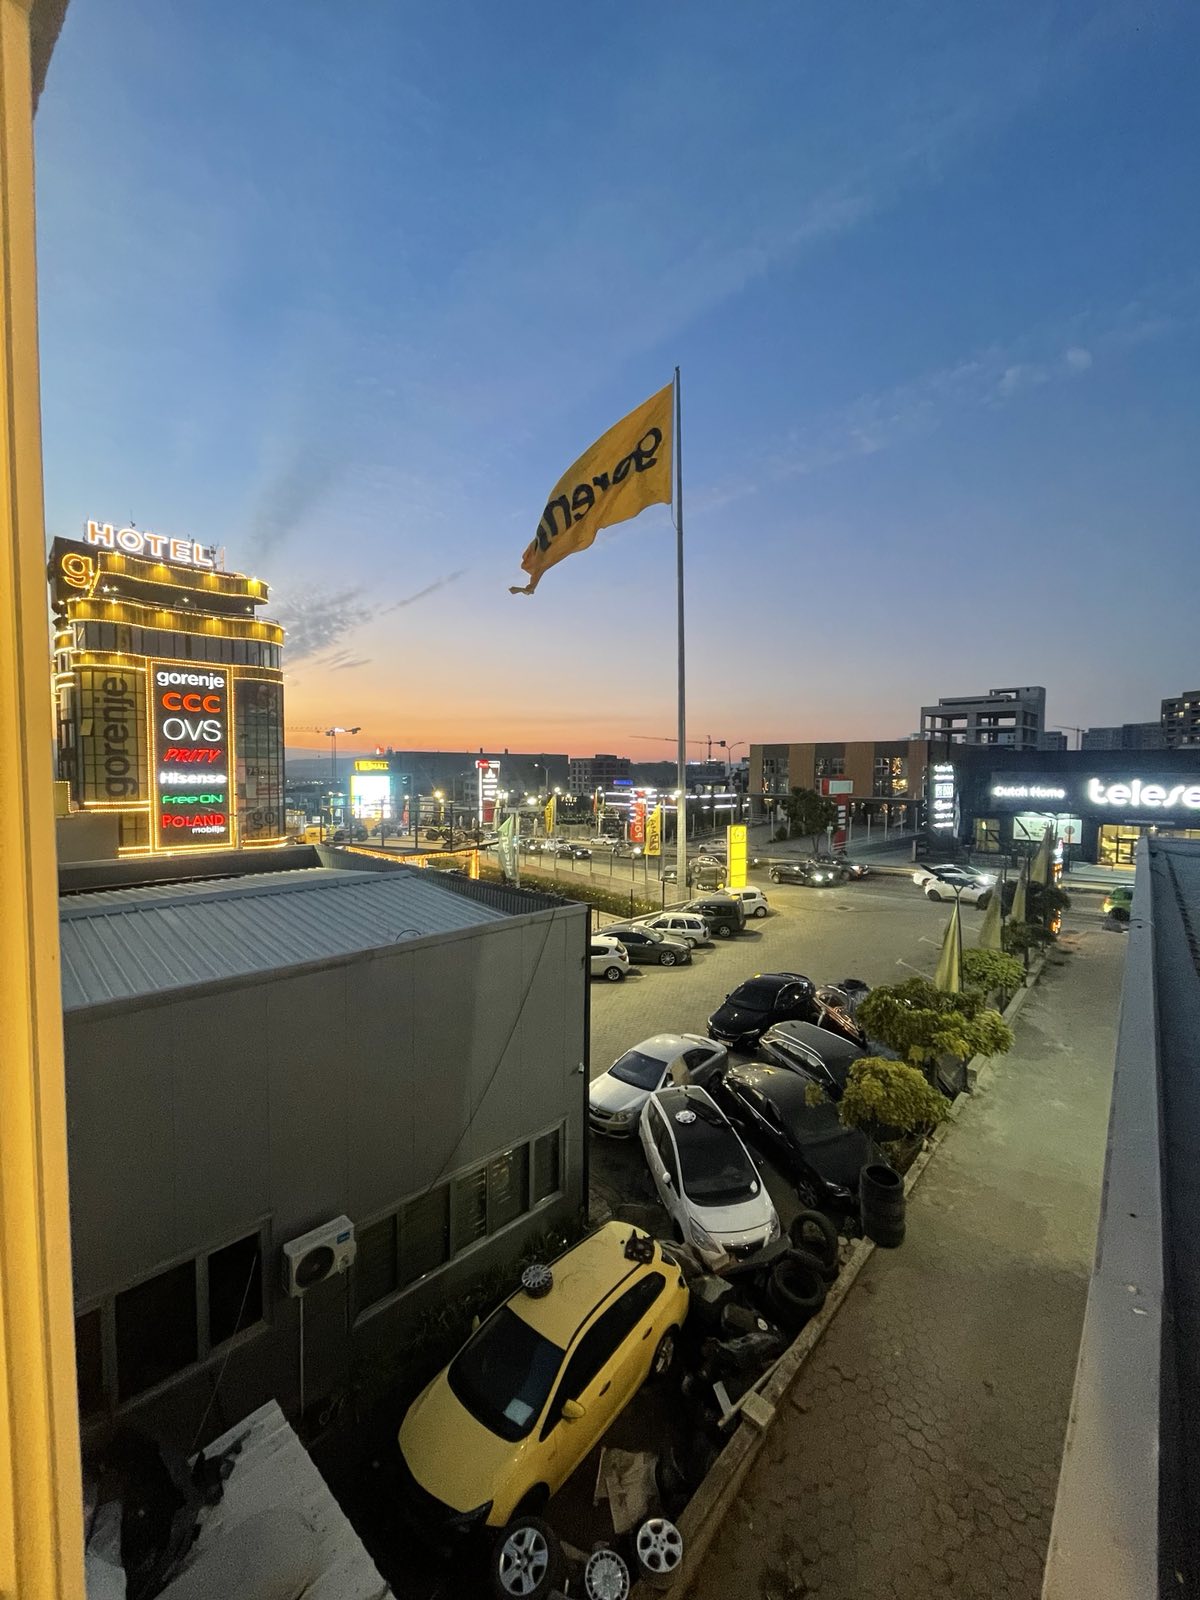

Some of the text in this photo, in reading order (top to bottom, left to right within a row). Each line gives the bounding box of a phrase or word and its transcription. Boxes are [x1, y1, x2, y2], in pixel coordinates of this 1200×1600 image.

[86, 520, 213, 566] HOTEL
[157, 670, 224, 689] gorenje
[162, 692, 221, 713] CCC
[96, 676, 135, 797] gorenje
[163, 718, 221, 742] OVS
[163, 748, 221, 764] PRITY
[159, 771, 226, 785] Hisense
[993, 786, 1066, 800] Dutch Home
[162, 814, 225, 828] POLAND
